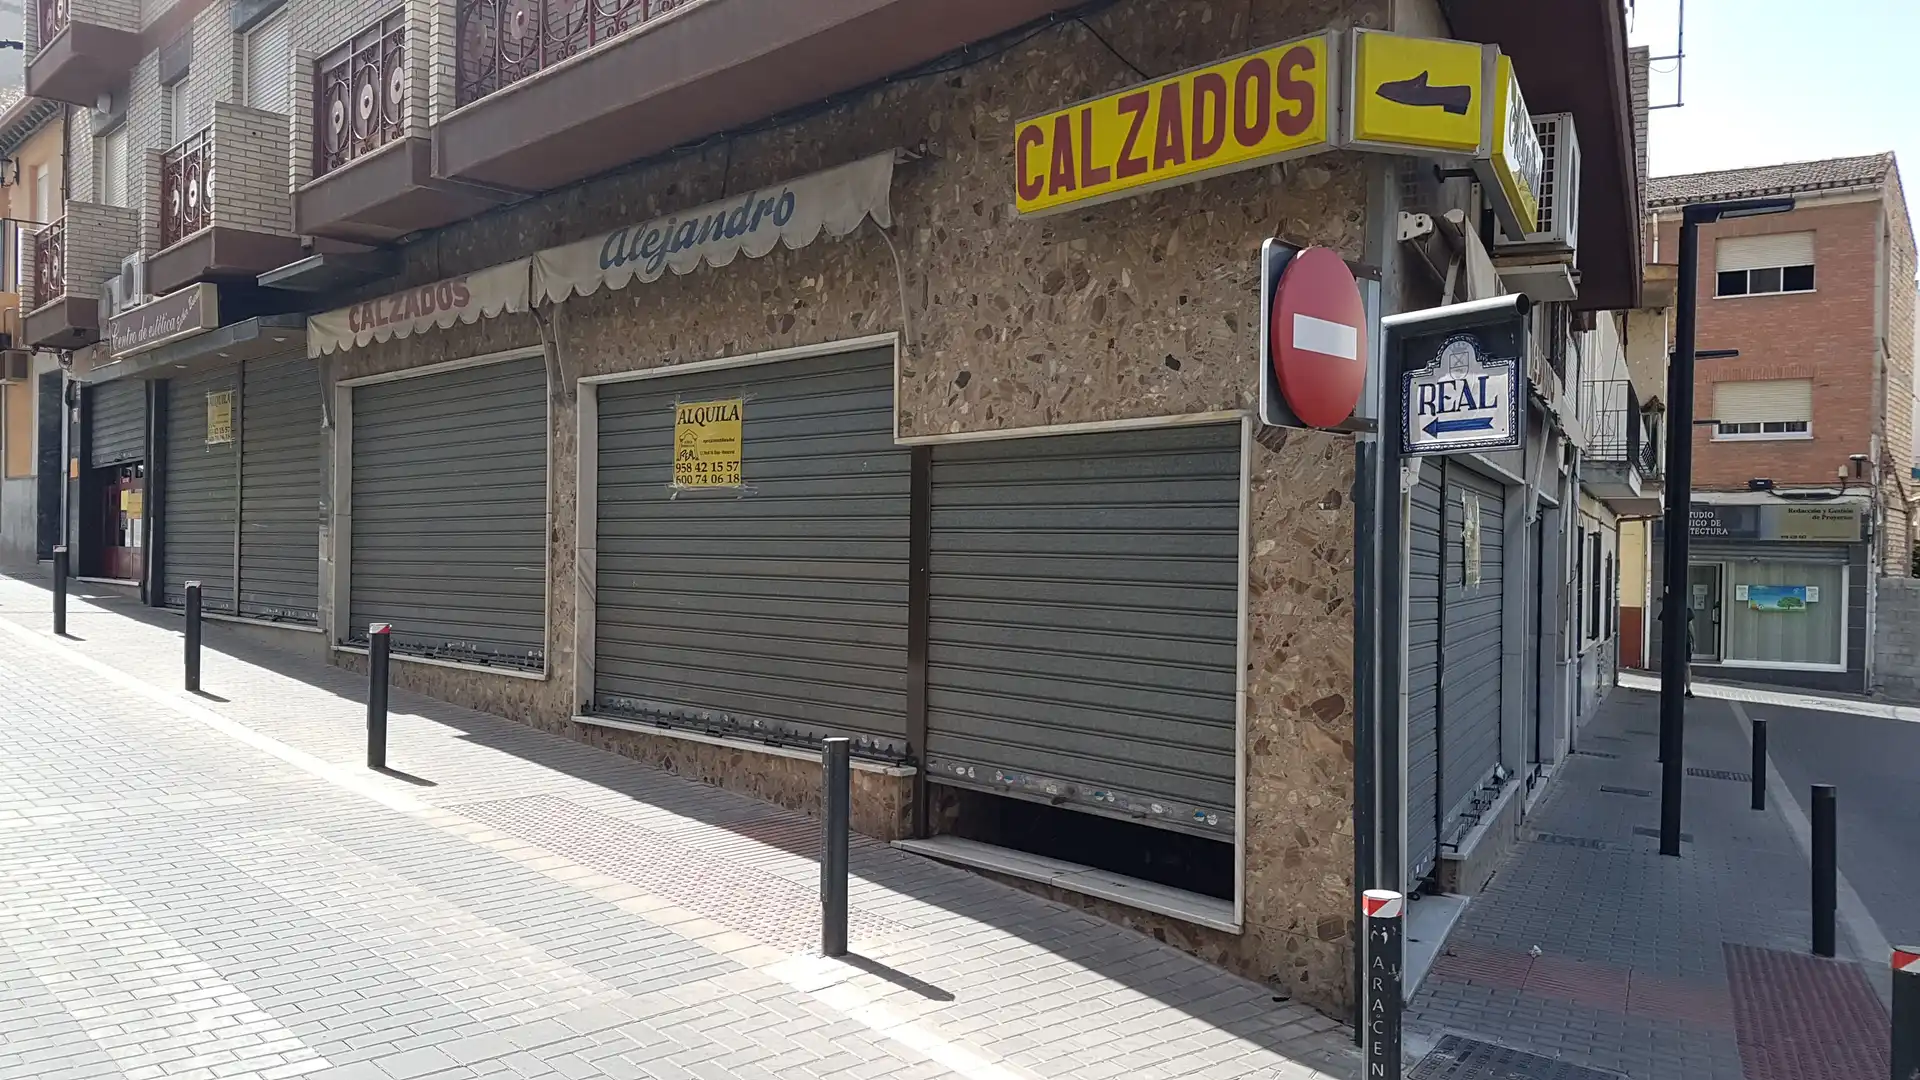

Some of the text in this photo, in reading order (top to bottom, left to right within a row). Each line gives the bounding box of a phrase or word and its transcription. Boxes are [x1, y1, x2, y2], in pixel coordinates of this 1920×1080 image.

[1017, 46, 1316, 201] CALZADOS
[600, 187, 795, 274] Alejandro
[349, 281, 470, 333] CALZADOS
[112, 322, 137, 350] Centro
[138, 315, 147, 341] de
[1418, 376, 1498, 416] REAL
[677, 405, 739, 427] ALQUILA
[676, 461, 740, 474] 958 42 15 57
[676, 474, 740, 485] 600 74 06 18
[1710, 519, 1721, 527] DE
